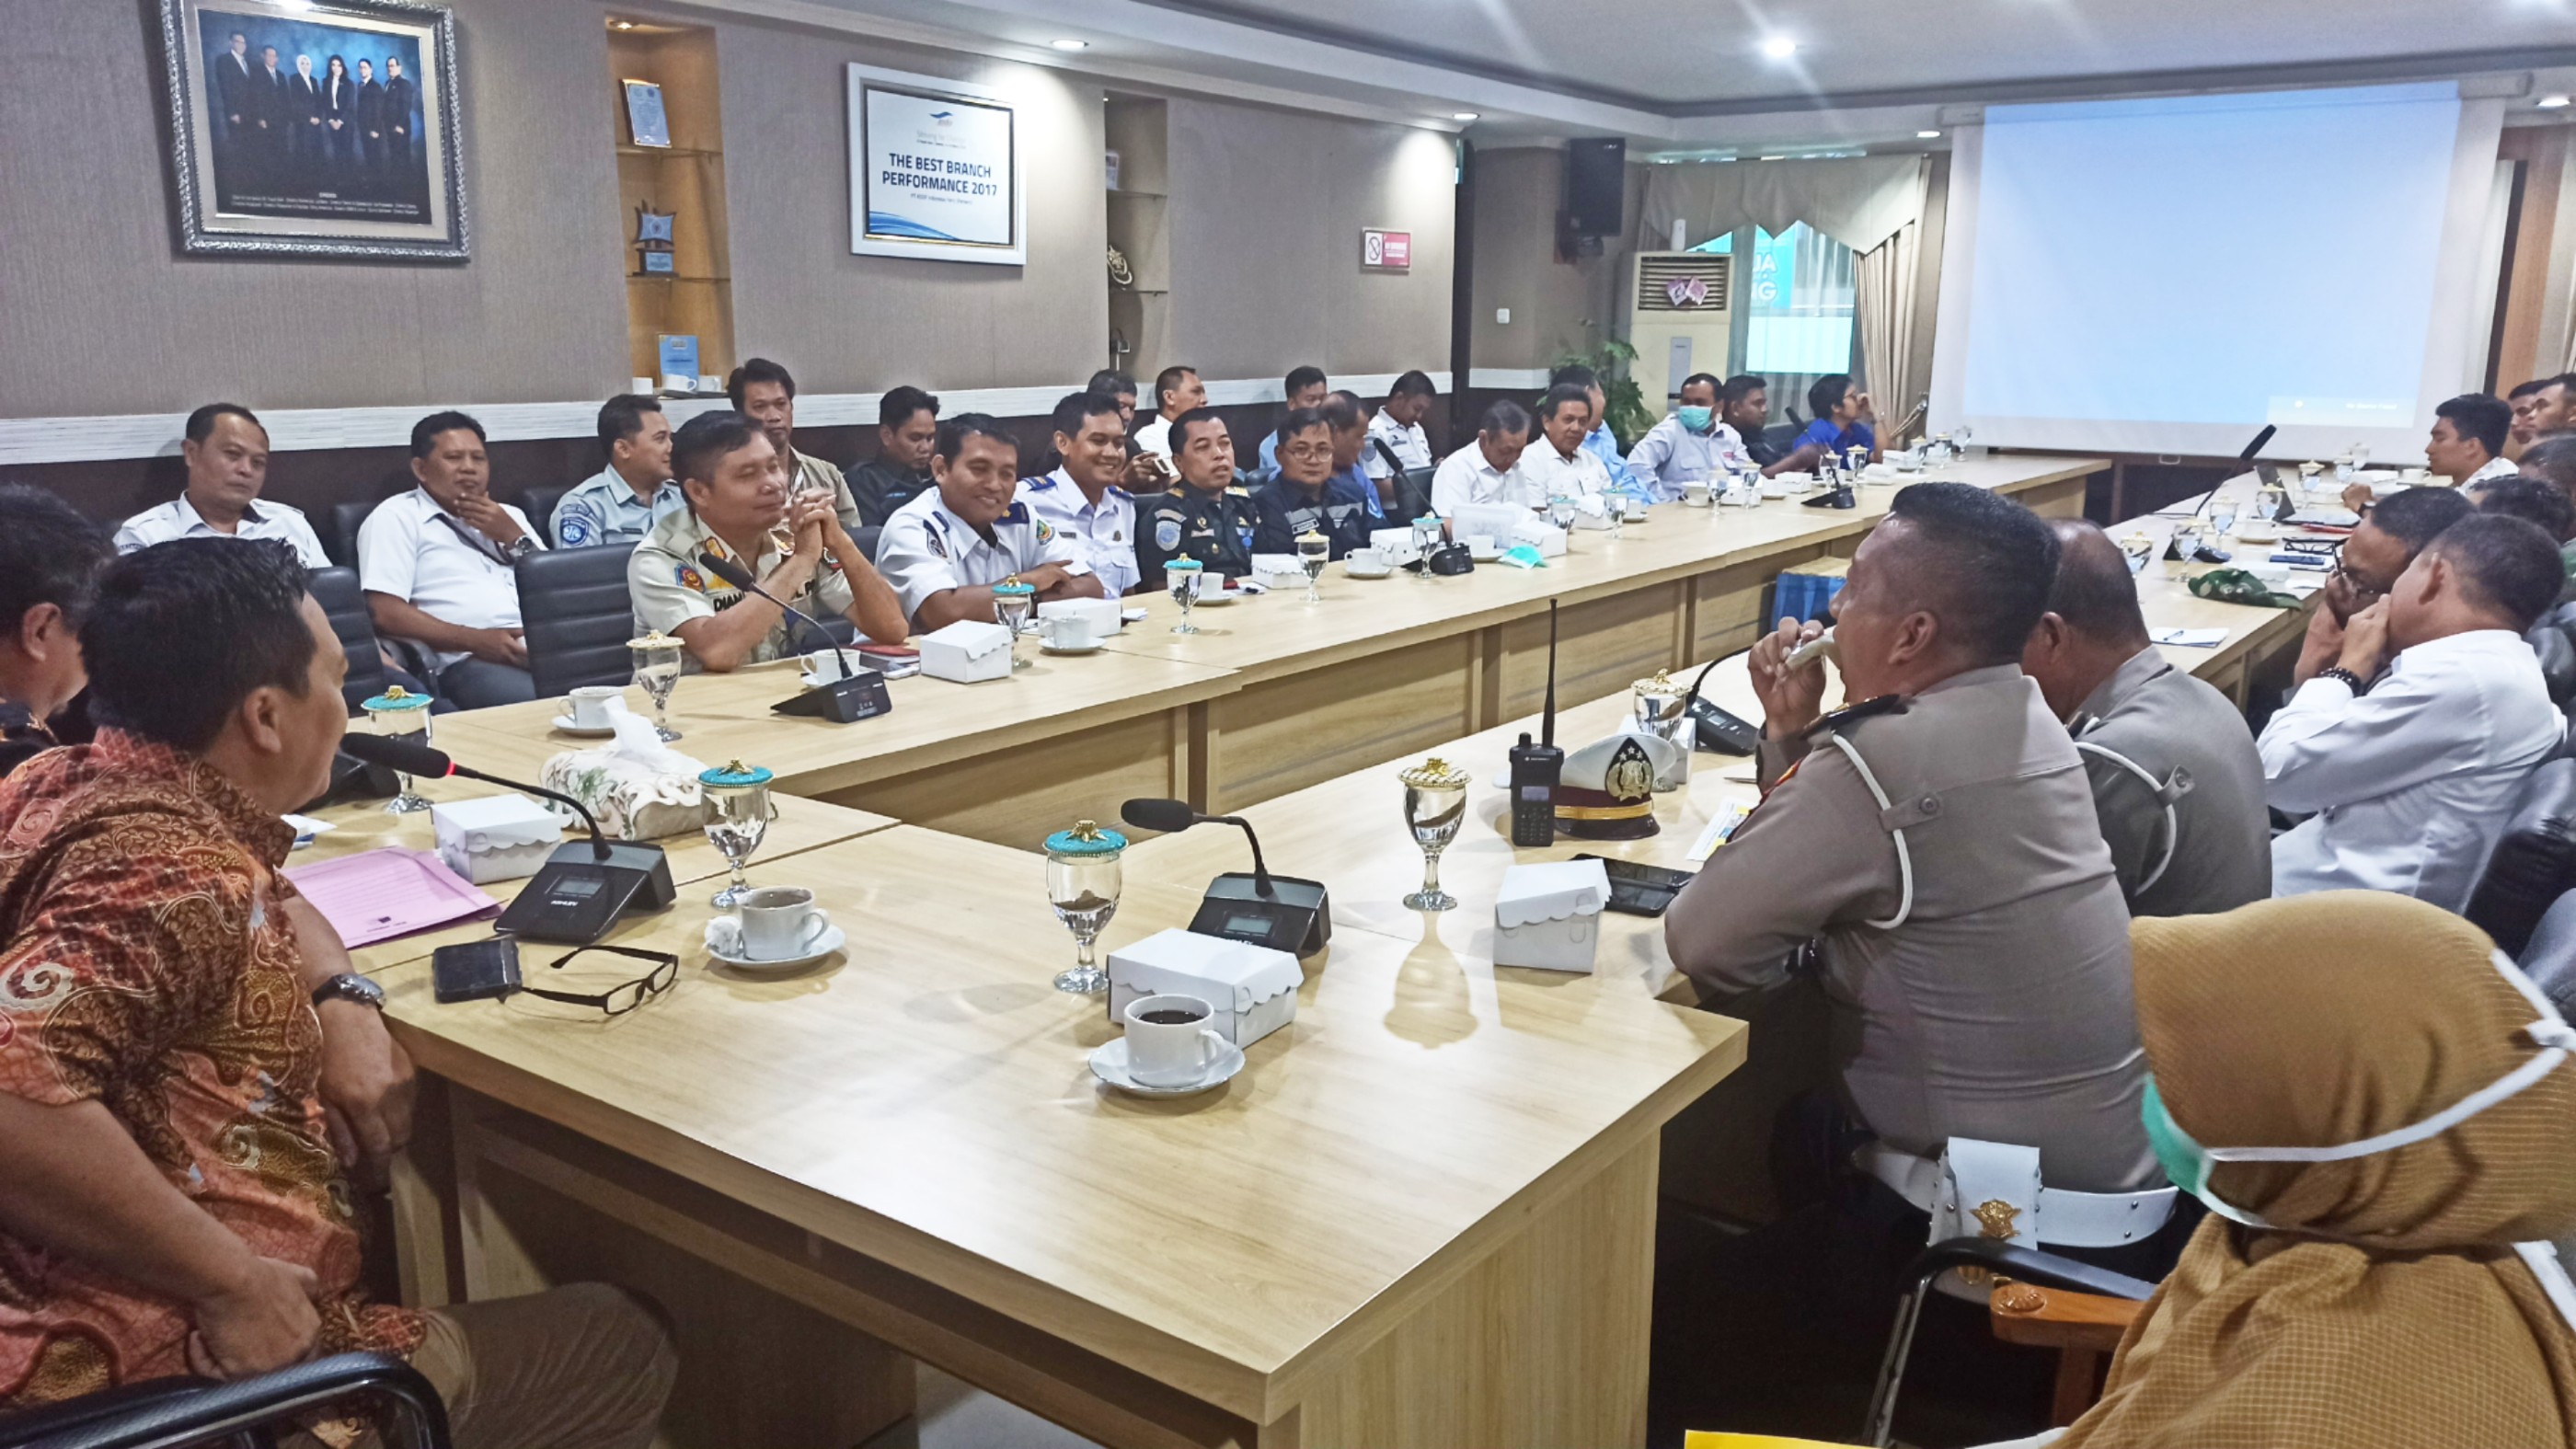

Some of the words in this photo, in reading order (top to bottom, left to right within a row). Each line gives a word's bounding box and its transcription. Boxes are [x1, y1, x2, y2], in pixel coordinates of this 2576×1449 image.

[889, 153, 913, 169] THE
[915, 156, 944, 172] BEST
[947, 160, 991, 178] BRANCH
[882, 170, 969, 193] PERFORMANCE
[972, 181, 997, 196] 2017
